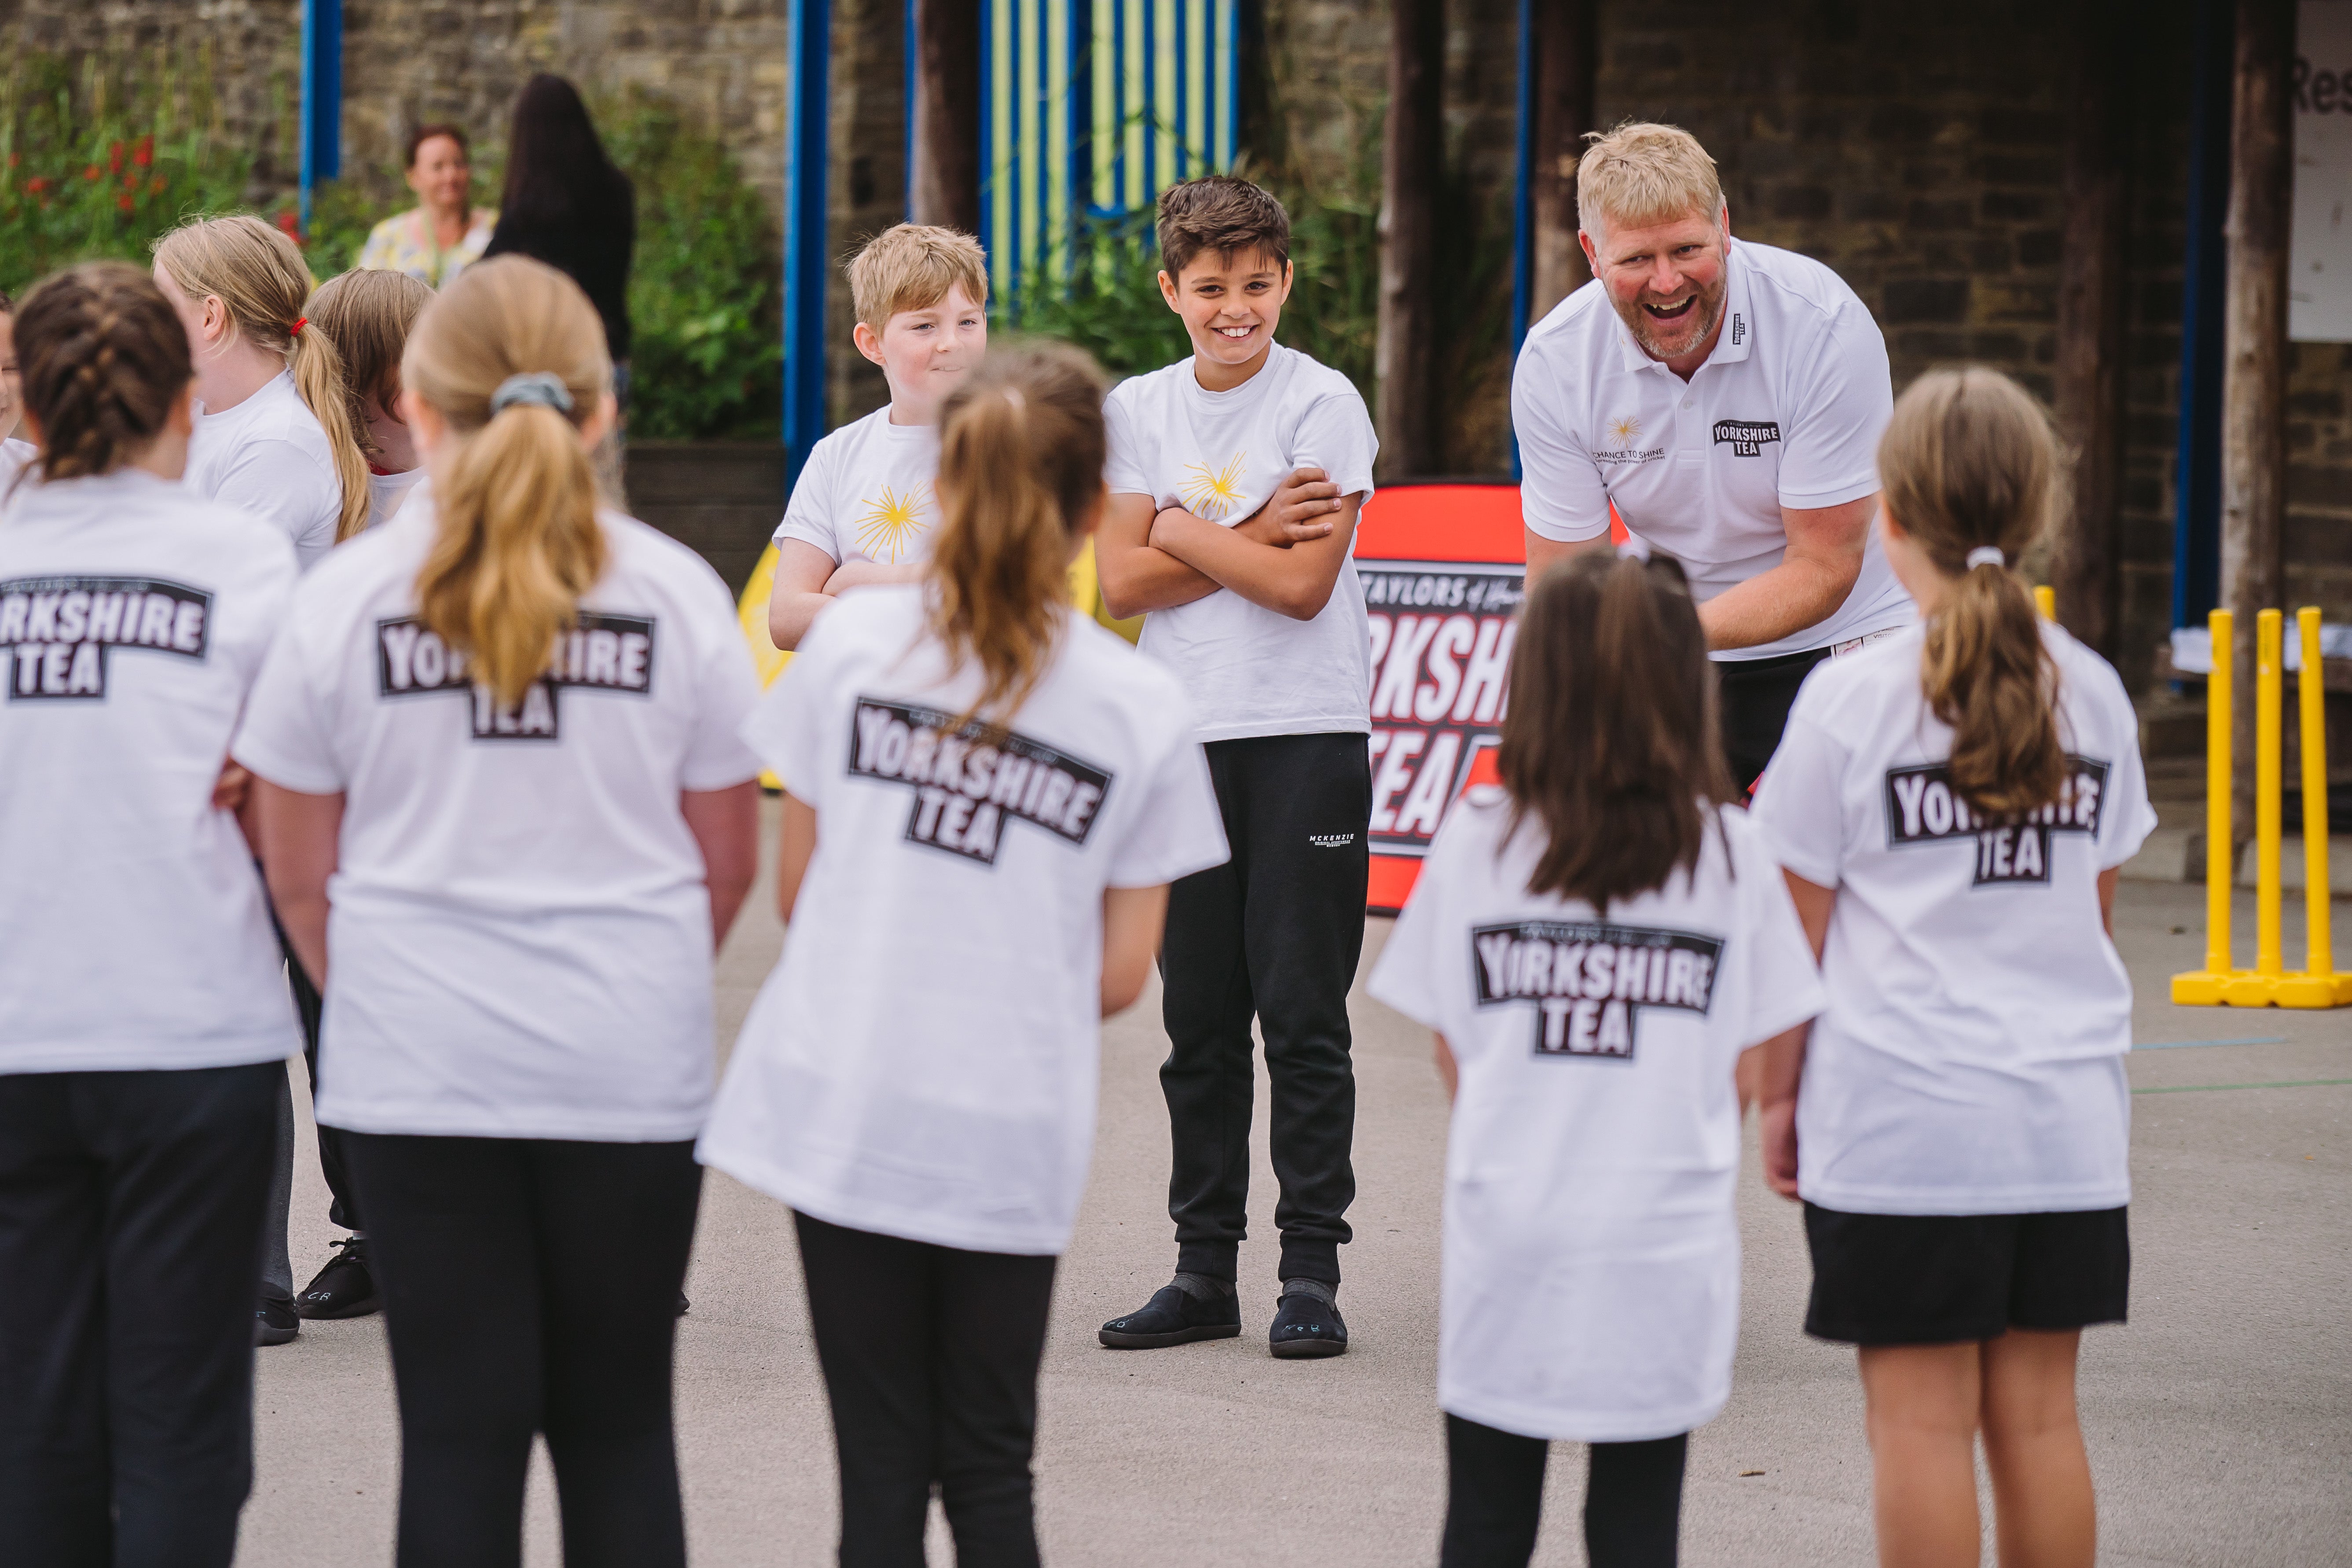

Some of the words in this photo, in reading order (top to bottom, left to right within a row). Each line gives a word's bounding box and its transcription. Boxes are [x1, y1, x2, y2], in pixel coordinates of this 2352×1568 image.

[1639, 448, 1664, 459] SHINE
[1715, 425, 1778, 441] YORKSHIRE
[1736, 441, 1757, 454] TEA
[1361, 573, 1468, 606] TAYLORS
[15, 643, 101, 694] TEA
[858, 706, 1101, 835] YORKSHIRE
[915, 786, 1001, 856] TEA
[1541, 998, 1629, 1053] TEA
